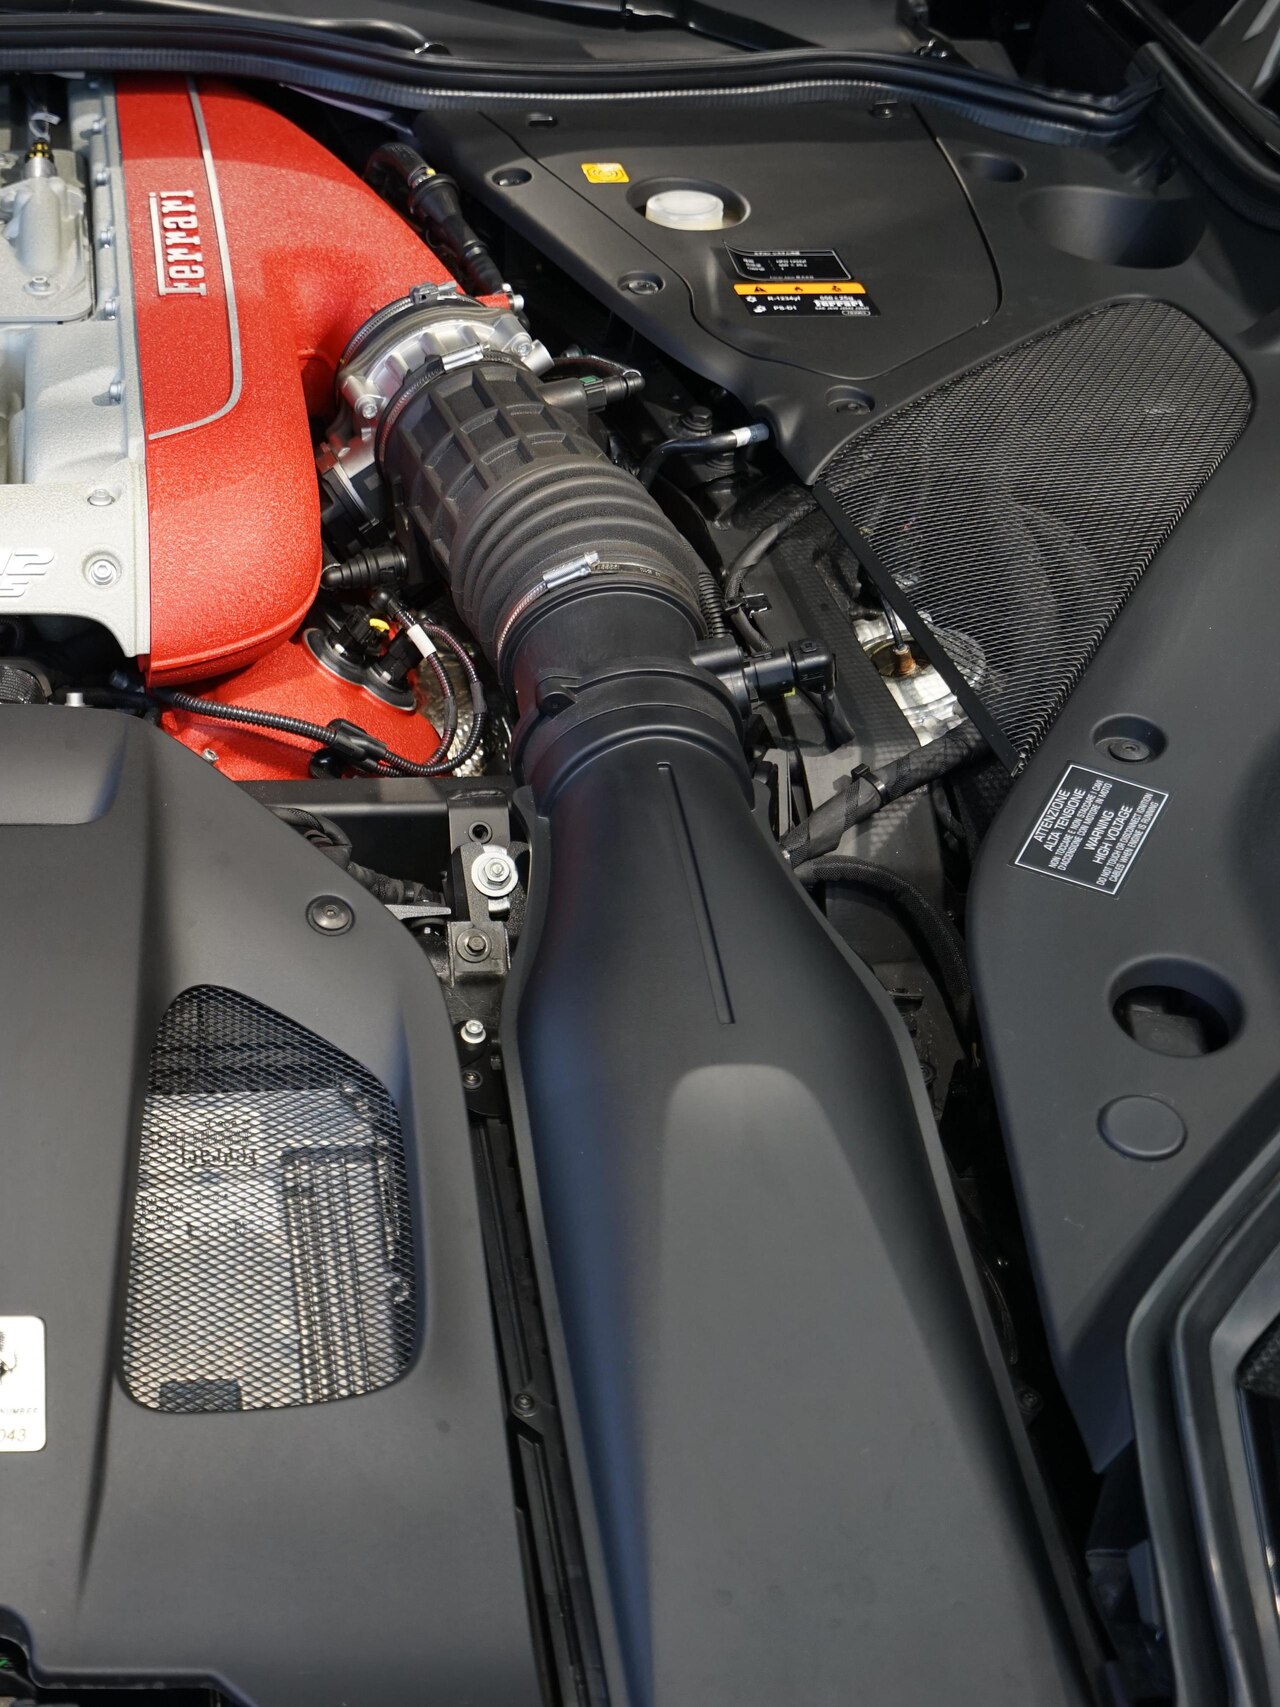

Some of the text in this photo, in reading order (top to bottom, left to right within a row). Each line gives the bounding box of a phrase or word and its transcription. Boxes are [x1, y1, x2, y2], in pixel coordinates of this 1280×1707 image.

[149, 189, 207, 296] Ferrari
[813, 299, 864, 307] Ferrari
[1033, 789, 1070, 842] ATTENZIONE
[1042, 788, 1086, 851] ALTA TENSIONE
[1048, 856, 1061, 868] NON
[1055, 834, 1073, 856] TOCCARE
[1070, 817, 1082, 829] NON
[1076, 794, 1095, 818] STACCARE
[1091, 779, 1104, 791] CAVI
[1077, 824, 1089, 836] CON
[1083, 803, 1100, 825] MOTORE
[1098, 782, 1112, 798] MOTO
[1083, 809, 1114, 851] WARNING
[1092, 805, 1132, 864] HIGH VOLTAGE
[1106, 849, 1121, 866] TOUCH
[1109, 863, 1125, 882] CABLES
[1119, 847, 1133, 863] WHEN
[1127, 829, 1143, 847] ENGINE
[1140, 801, 1159, 824] RUNNING
[1115, 841, 1126, 850] OR
[1096, 876, 1107, 885] DO
[1100, 866, 1112, 877] NOT
